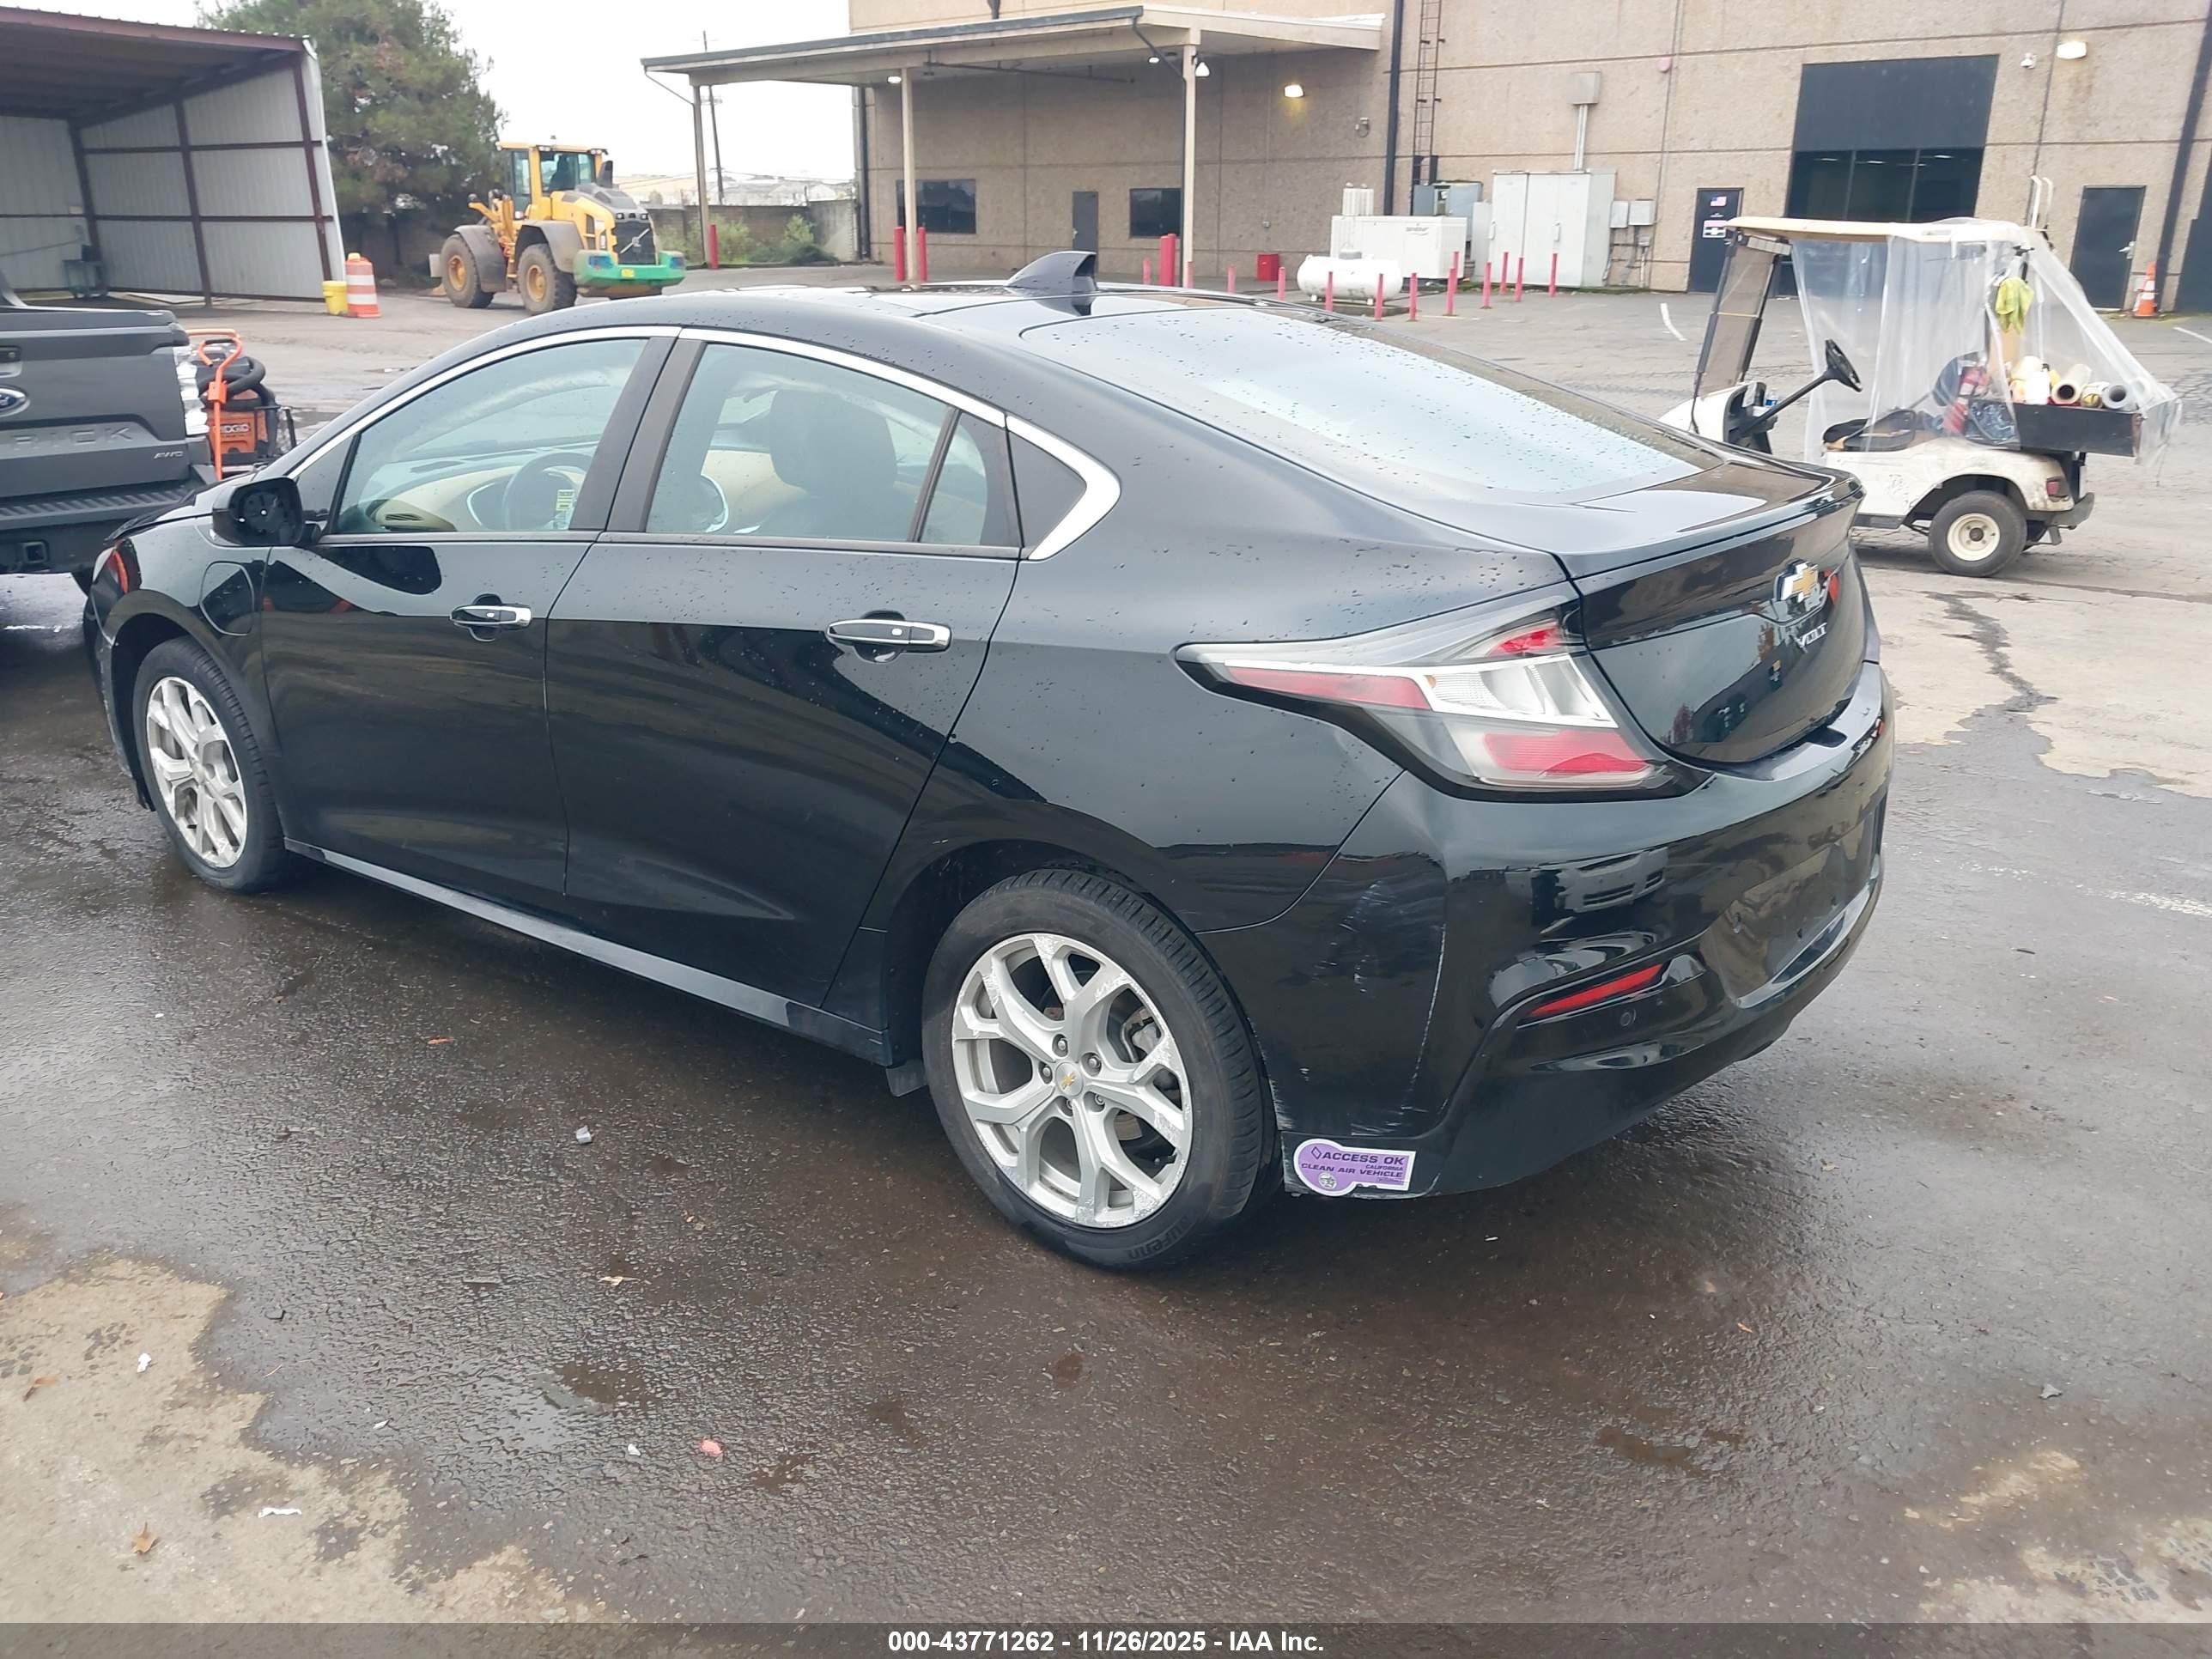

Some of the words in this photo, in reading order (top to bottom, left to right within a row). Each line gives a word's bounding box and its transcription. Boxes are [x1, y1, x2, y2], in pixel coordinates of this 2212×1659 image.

[1794, 623, 1827, 647] VOLT
[1322, 1151, 1378, 1164] ACCESS
[1383, 1156, 1406, 1165] OK
[1301, 1163, 1335, 1172] CLEAN
[1359, 1169, 1403, 1178] VEHICLE
